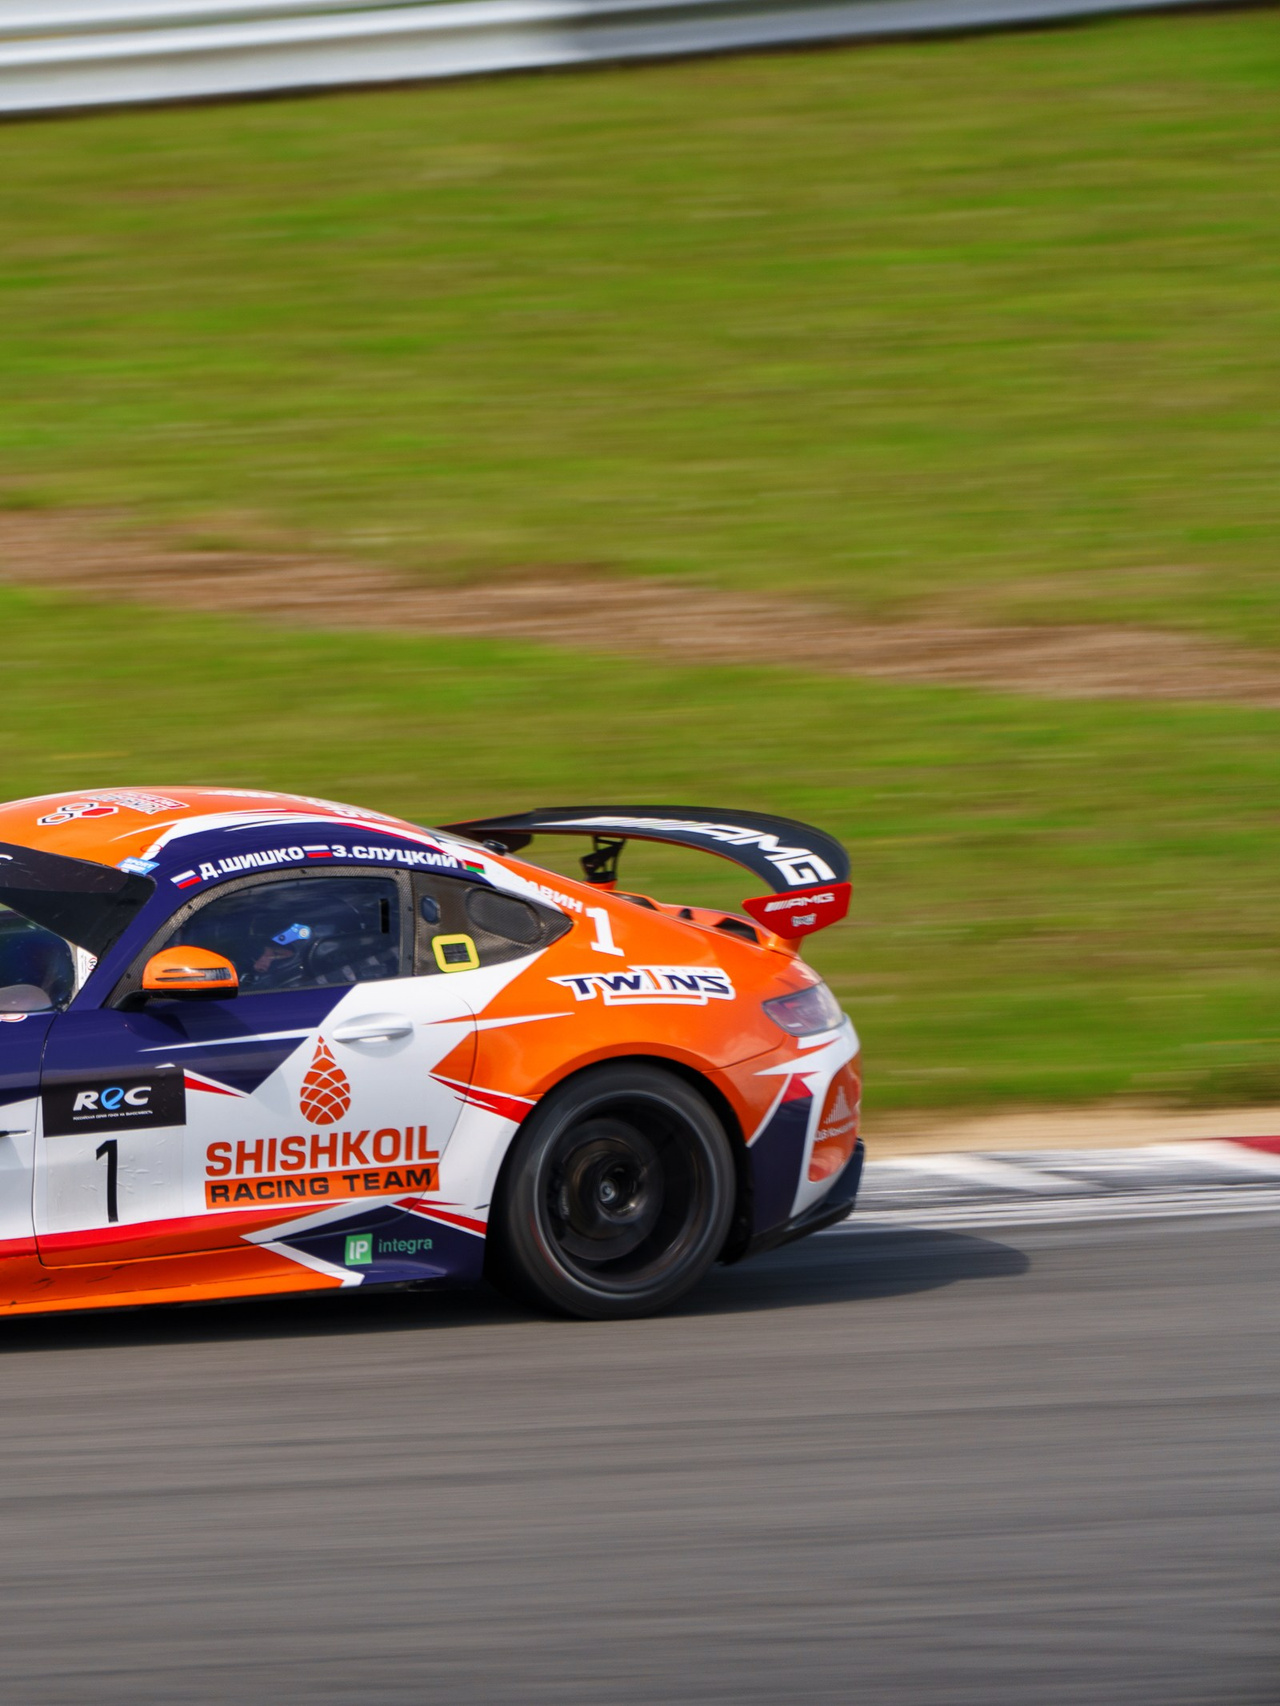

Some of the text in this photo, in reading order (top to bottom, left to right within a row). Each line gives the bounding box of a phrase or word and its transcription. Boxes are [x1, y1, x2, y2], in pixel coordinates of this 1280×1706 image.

[199, 846, 306, 881] Д.ШИШКО
[331, 845, 459, 869] З.СЛУЦКИЙ
[585, 906, 625, 957] 1
[205, 1125, 440, 1177] SHISHKOIL
[95, 1138, 119, 1224] 1
[210, 1168, 432, 1203] RACING TEAM
[349, 1238, 433, 1260] IP integra
